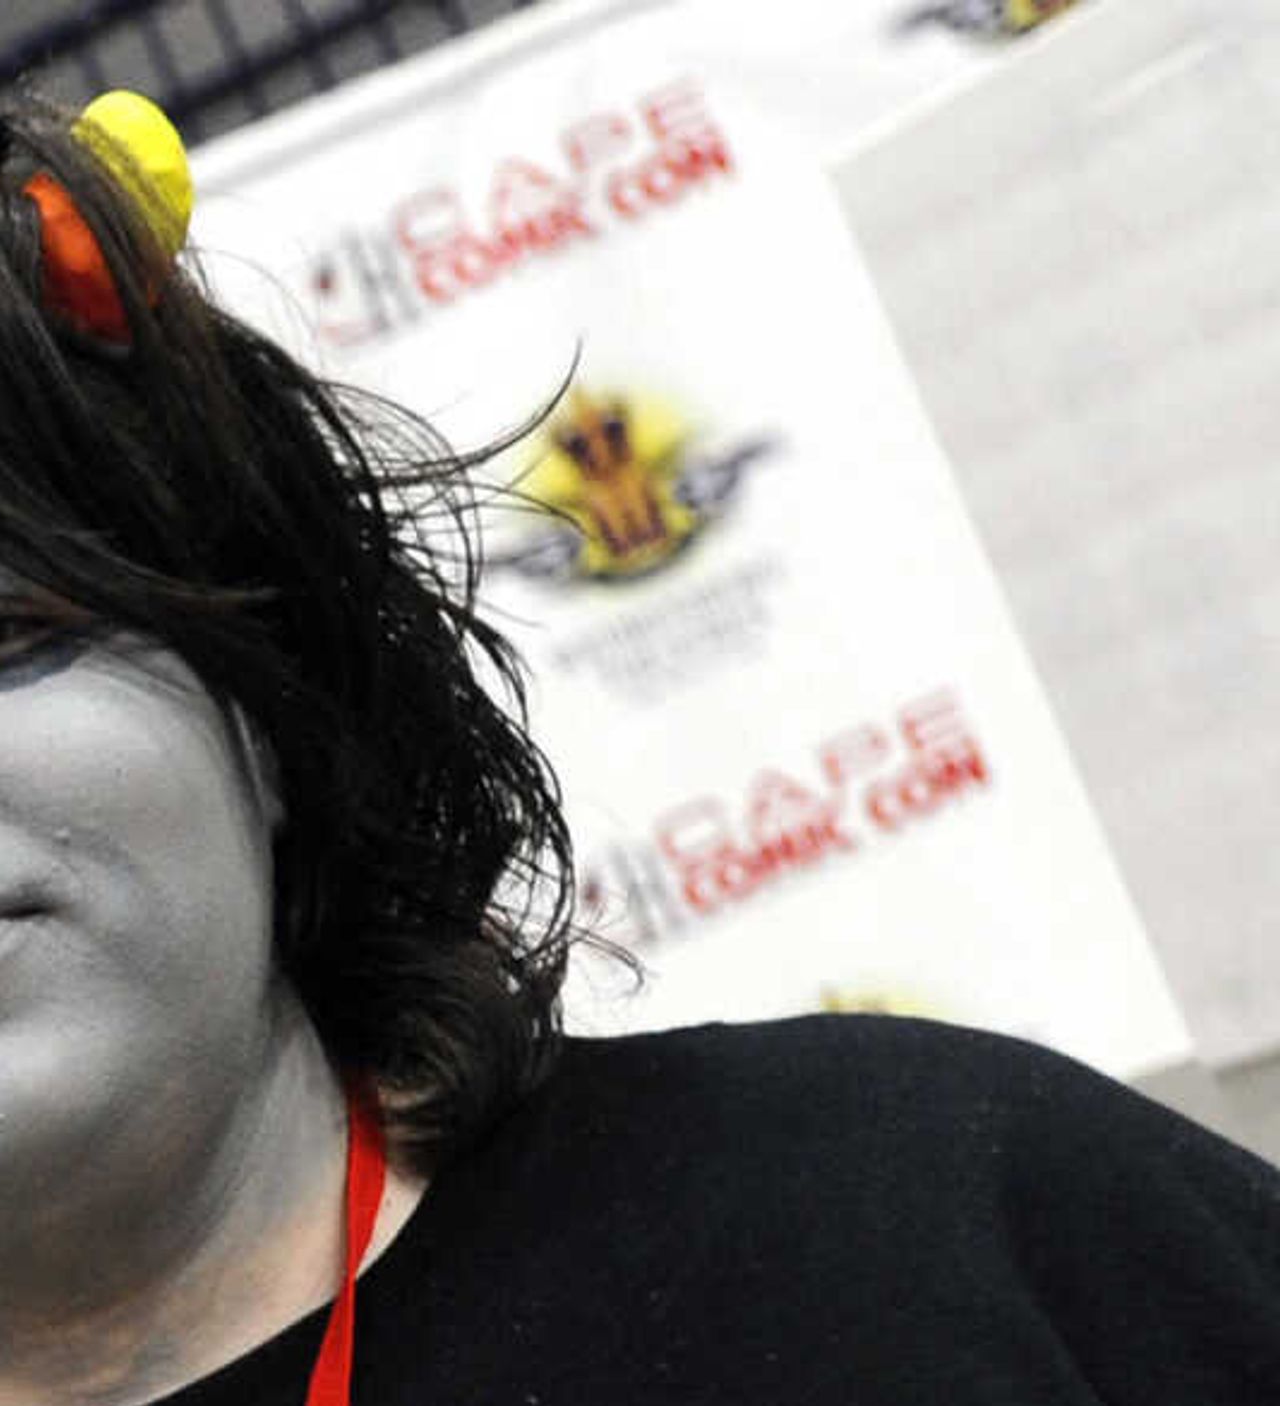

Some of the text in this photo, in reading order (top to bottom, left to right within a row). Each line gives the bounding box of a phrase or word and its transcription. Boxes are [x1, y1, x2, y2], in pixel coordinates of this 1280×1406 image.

[413, 125, 735, 306] COMIC CON
[680, 736, 993, 914] COMIC CON
